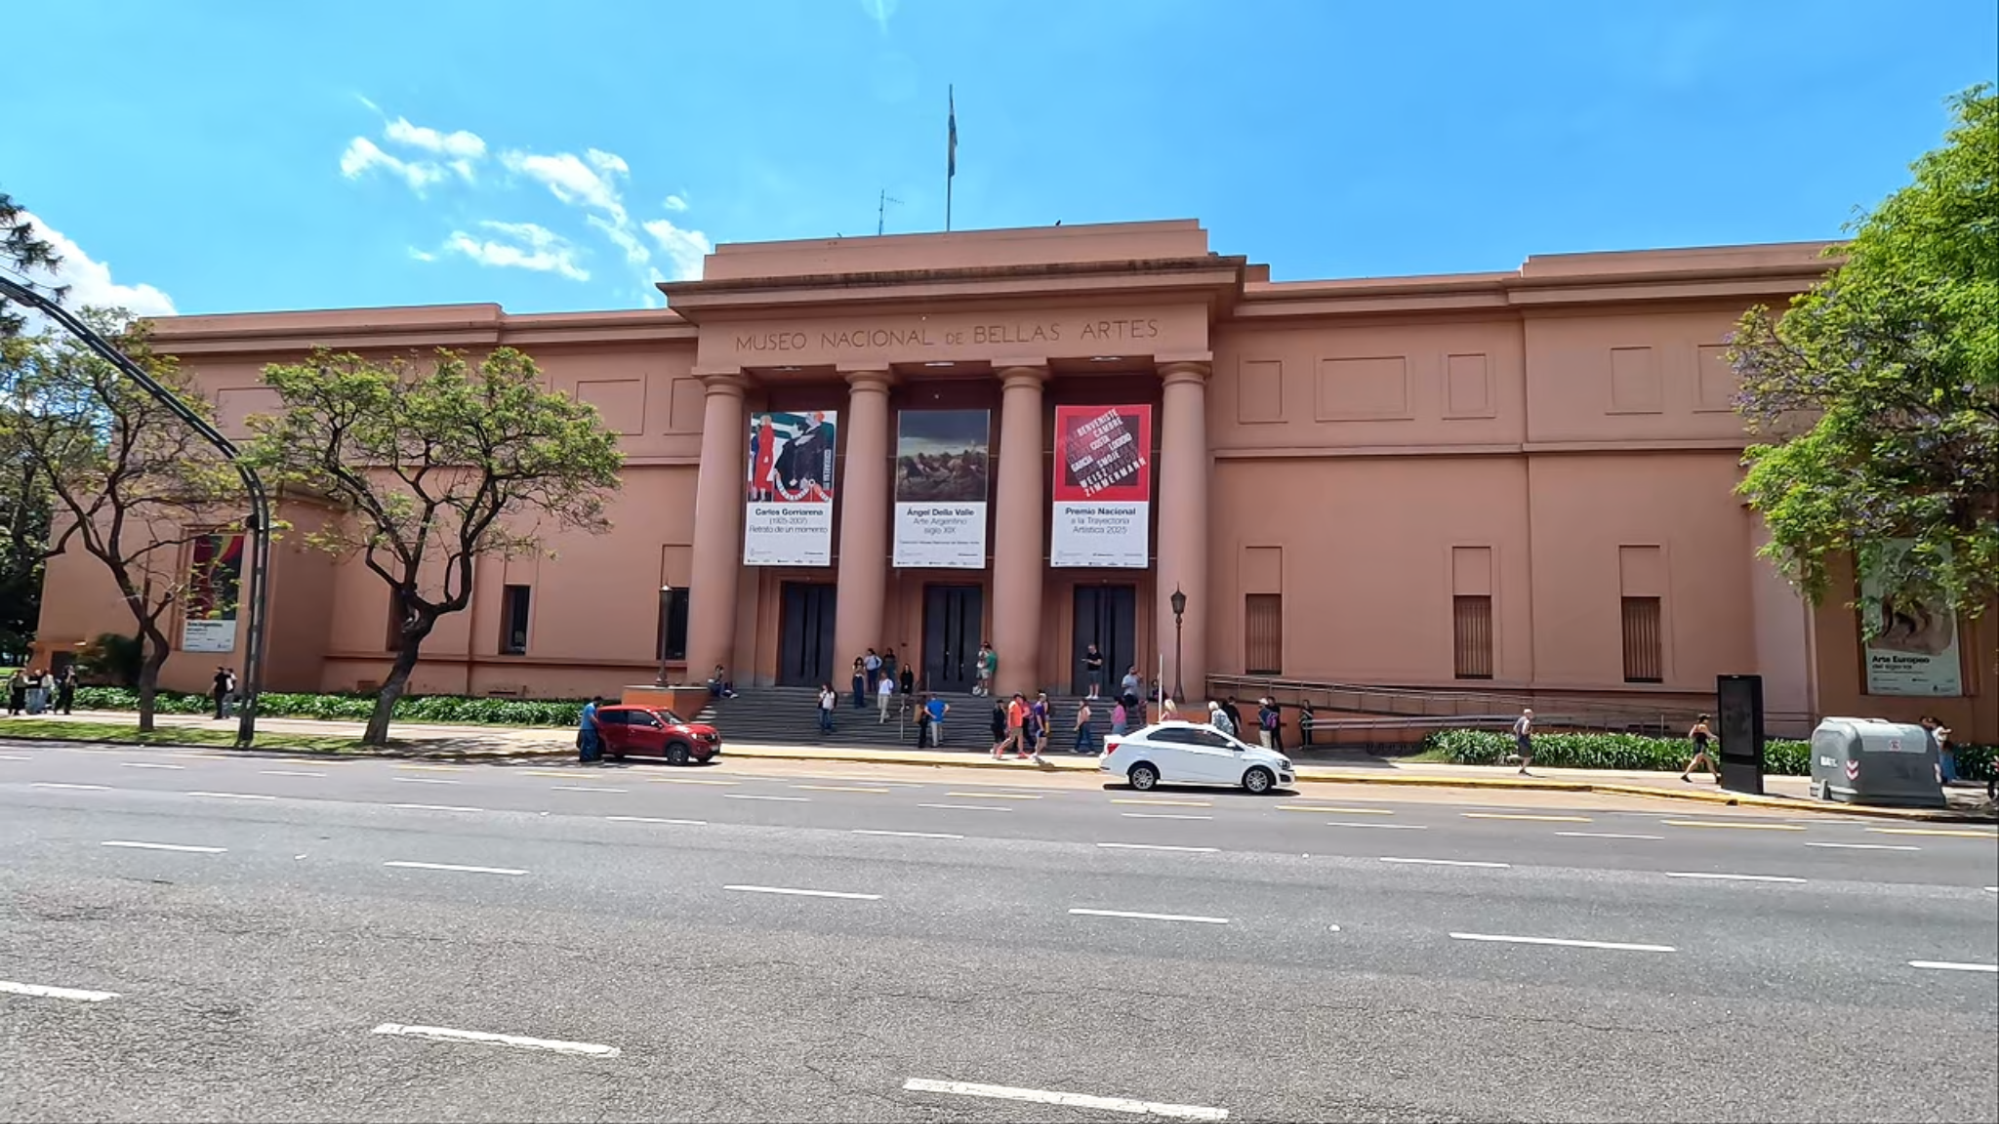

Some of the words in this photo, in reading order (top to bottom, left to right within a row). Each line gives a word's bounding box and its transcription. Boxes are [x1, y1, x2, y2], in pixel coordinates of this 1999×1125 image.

[736, 332, 807, 351] MUSEO
[821, 329, 934, 349] NACIONAL
[945, 332, 964, 345] DE
[974, 323, 1060, 344] BELLAS
[1080, 319, 1159, 340] ARTES
[1079, 468, 1108, 488] WEISZ
[1084, 456, 1147, 498] ZIMMERMANN
[755, 508, 780, 516] Carlos
[907, 507, 930, 518] Ángel
[932, 508, 953, 516] Della
[955, 508, 975, 516] Valle
[1065, 507, 1095, 515] Premio
[1098, 507, 1136, 515] Nacional
[931, 518, 967, 526] Argentino
[1088, 517, 1130, 526] Trayectoria
[749, 525, 773, 533] Retrato
[775, 525, 783, 533] de
[795, 526, 828, 534] momento
[924, 527, 942, 535] siglo
[1106, 526, 1128, 534] 2025
[1872, 655, 1890, 663] Arte
[1892, 656, 1930, 664] Europeo
